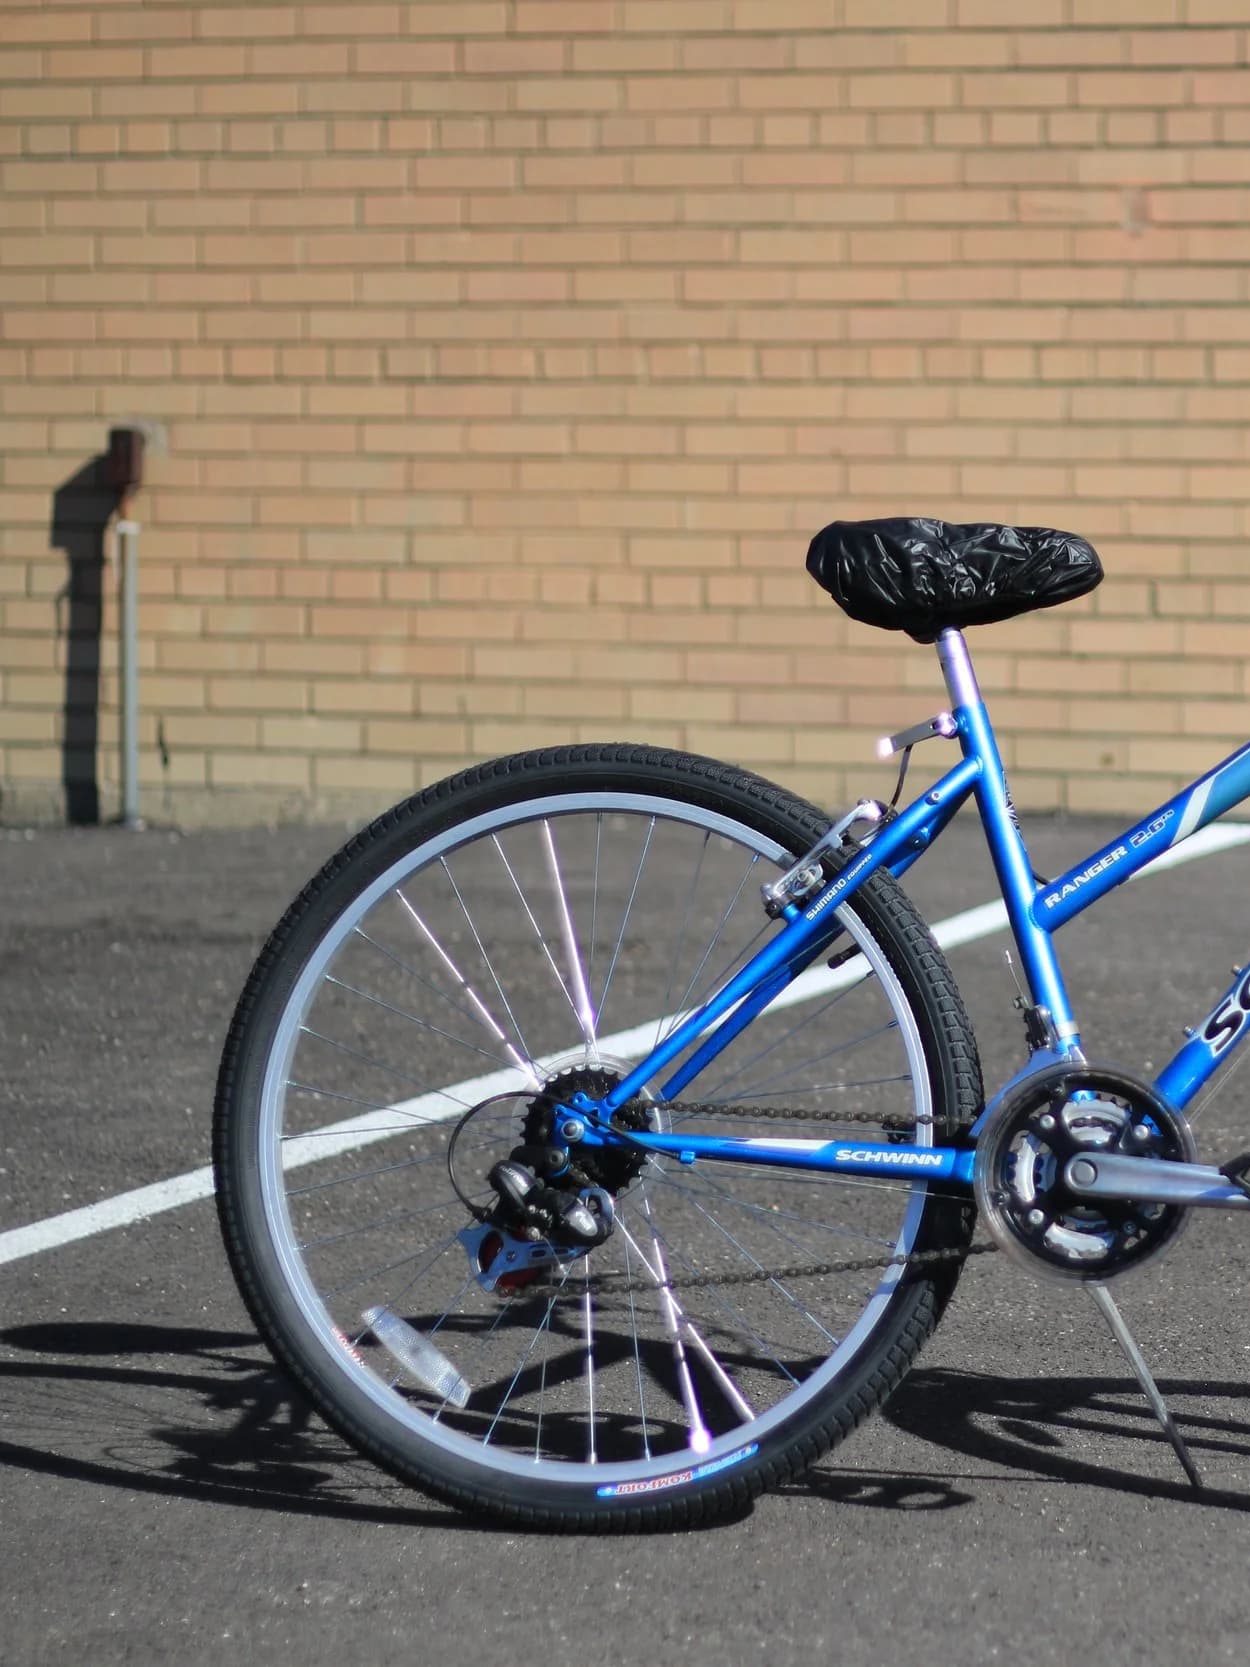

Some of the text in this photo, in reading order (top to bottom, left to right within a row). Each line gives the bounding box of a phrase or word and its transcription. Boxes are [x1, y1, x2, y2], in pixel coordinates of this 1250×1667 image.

[1044, 845, 1128, 909] RANGER
[806, 878, 847, 921] SHIMANO
[836, 1149, 943, 1165] SCHWINN
[615, 1471, 694, 1495] KOMFORT
